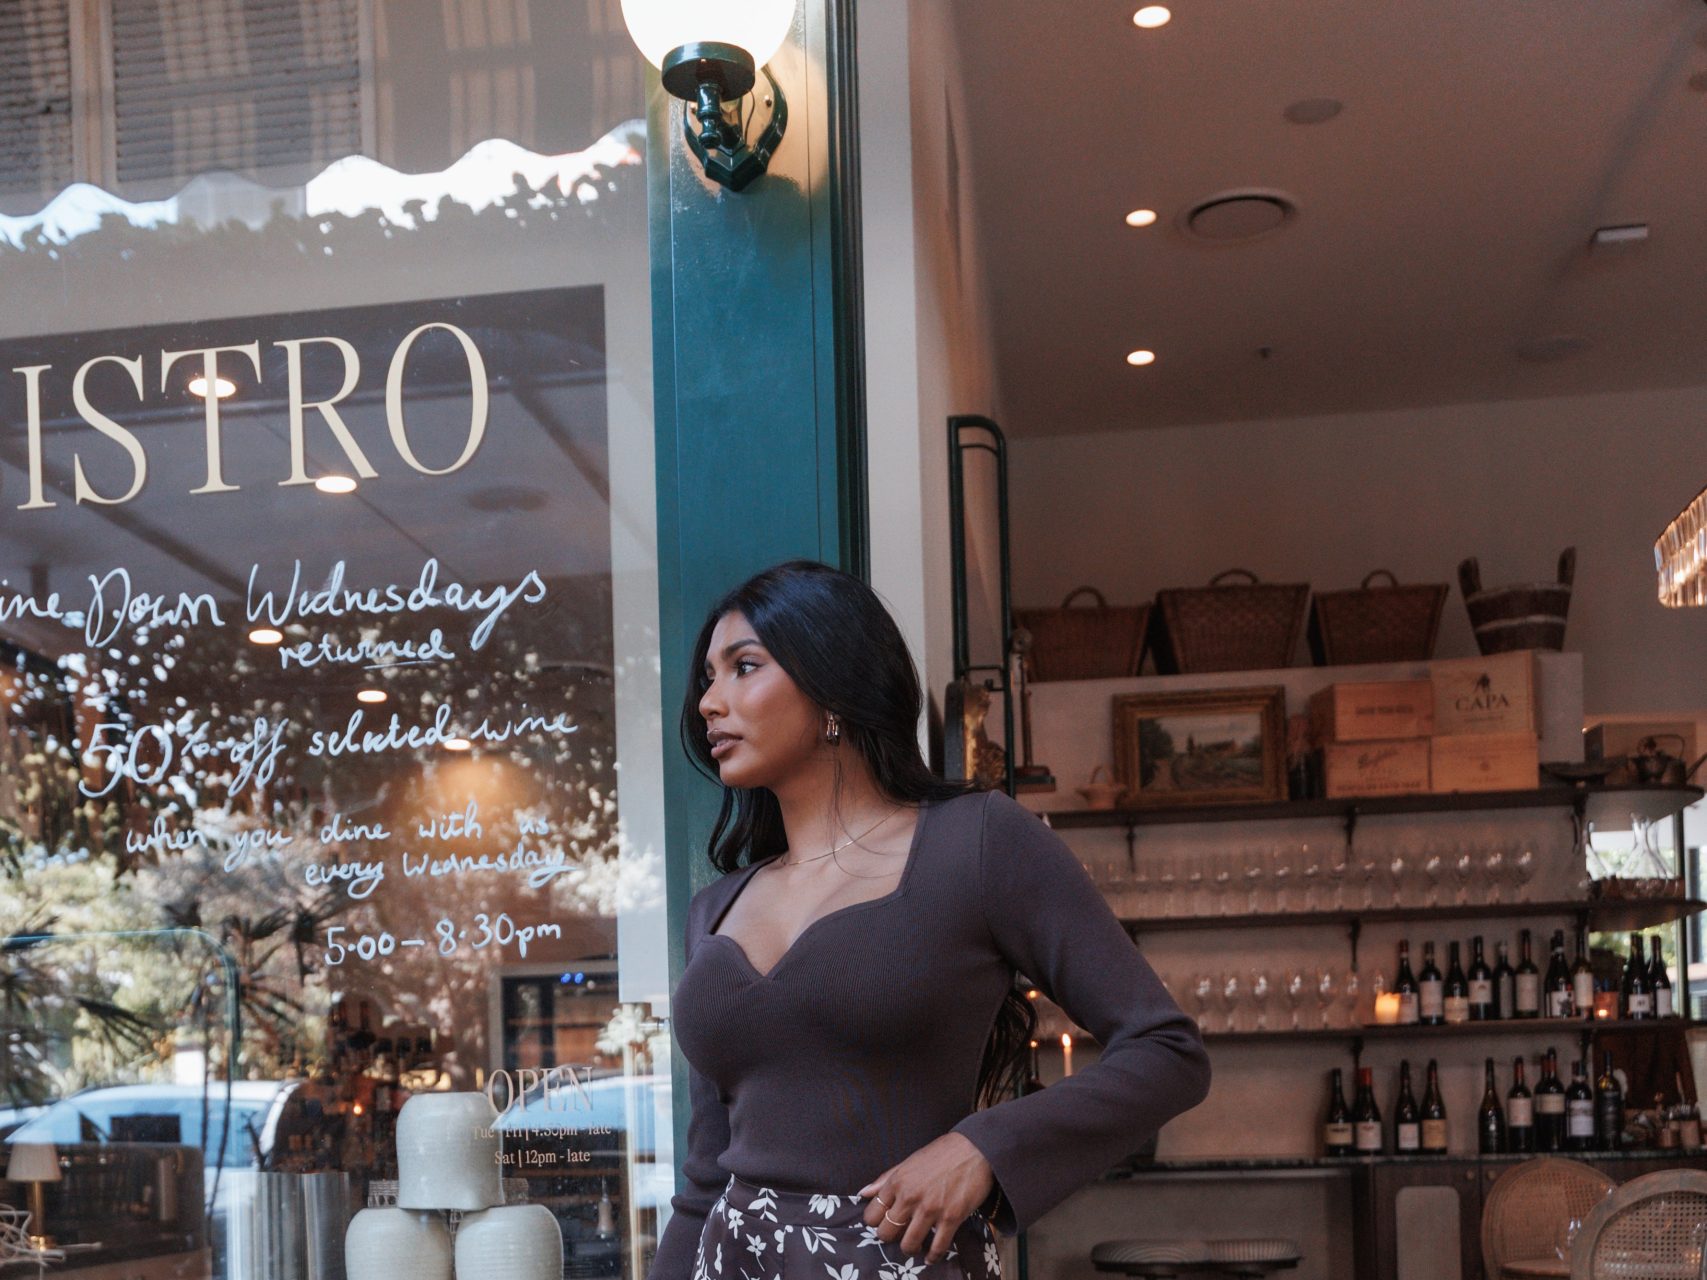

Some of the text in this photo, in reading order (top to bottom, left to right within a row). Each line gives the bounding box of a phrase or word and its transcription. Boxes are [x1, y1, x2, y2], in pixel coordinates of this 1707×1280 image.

[12, 322, 489, 510] ISTRO
[85, 567, 226, 648] Down
[247, 558, 547, 651] Wednesdays
[279, 629, 456, 669] returned
[78, 703, 578, 798] 50% off selected wine
[125, 800, 550, 873] when you dine with us
[305, 848, 578, 899] every Wednesday
[487, 1067, 594, 1115] OPEN
[494, 1150, 514, 1165] Sat
[525, 1149, 557, 1167] 12pm
[567, 1148, 591, 1162] late
